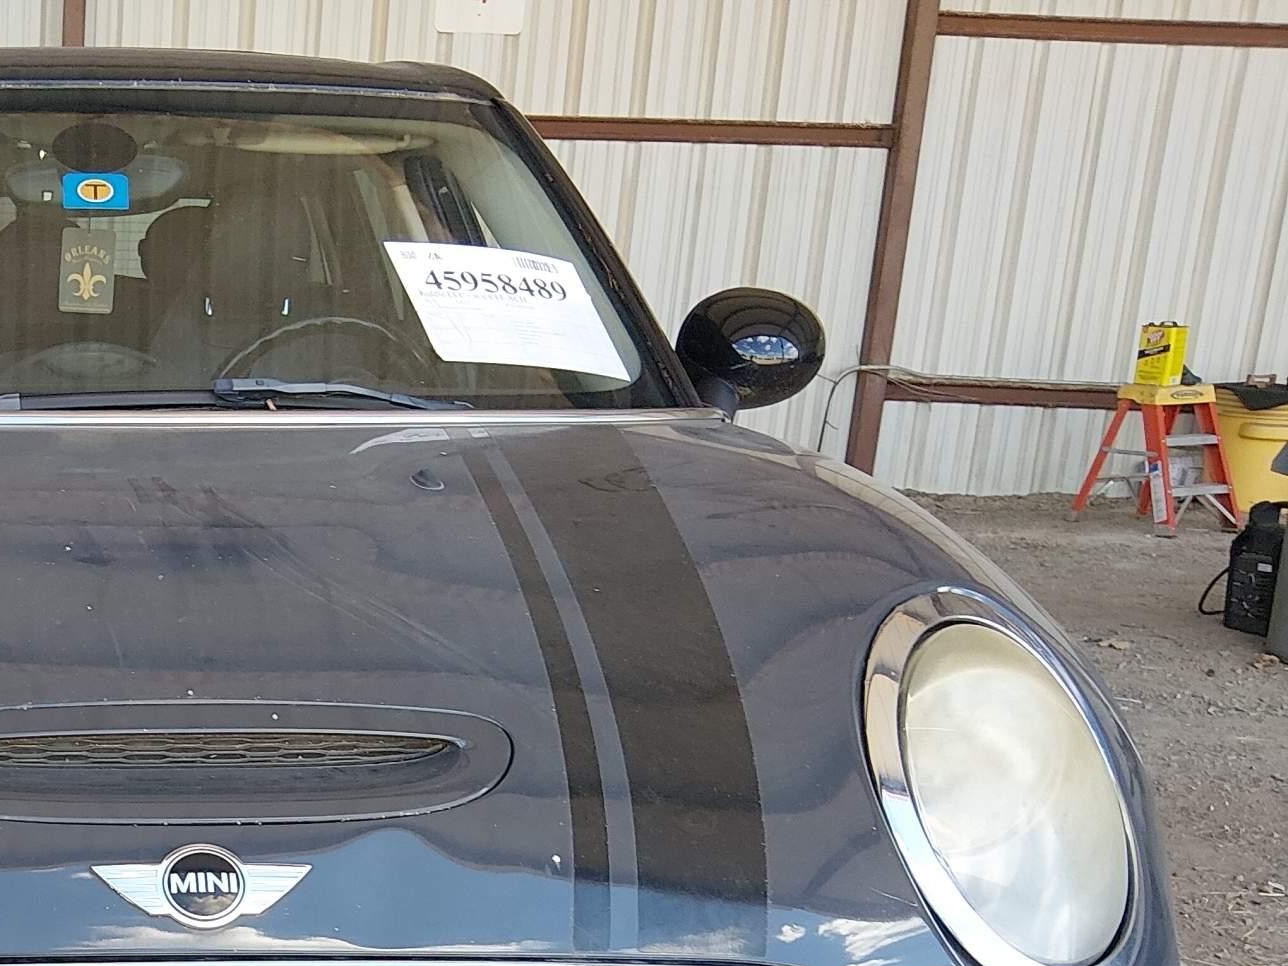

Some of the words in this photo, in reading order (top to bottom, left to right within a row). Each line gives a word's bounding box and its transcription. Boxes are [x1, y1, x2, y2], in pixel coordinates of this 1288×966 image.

[84, 183, 108, 201] T
[64, 245, 111, 265] ORLEANS
[425, 269, 567, 302] 45958489
[169, 871, 238, 895] MINI
